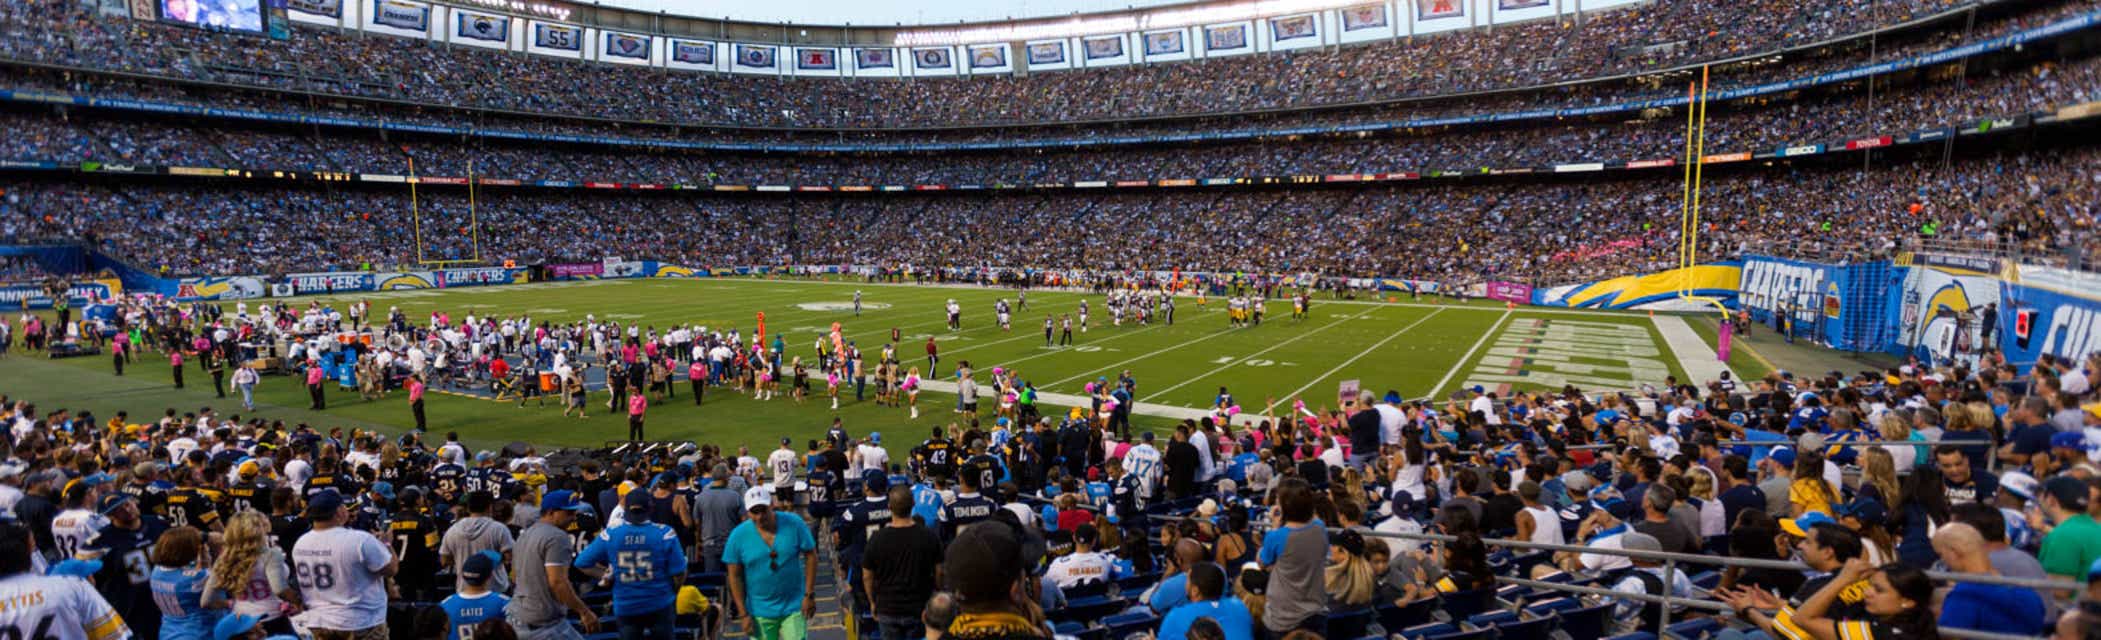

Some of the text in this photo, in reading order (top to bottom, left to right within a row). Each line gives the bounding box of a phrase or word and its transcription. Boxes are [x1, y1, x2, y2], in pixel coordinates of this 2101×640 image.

[549, 30, 569, 46] 55
[1785, 145, 1816, 157] GEICO
[292, 272, 361, 291] HARGERS
[446, 265, 505, 285] CHAGERS
[930, 450, 947, 465] 43
[778, 460, 789, 473] 13
[1133, 458, 1153, 478] 17
[980, 469, 994, 488] 13
[809, 486, 828, 502] 32
[168, 505, 189, 528] 58
[953, 505, 991, 518] TOMLINSON
[397, 534, 409, 562] 7
[624, 535, 647, 545] SEAU
[616, 551, 654, 583] 55
[460, 607, 484, 617] GATES
